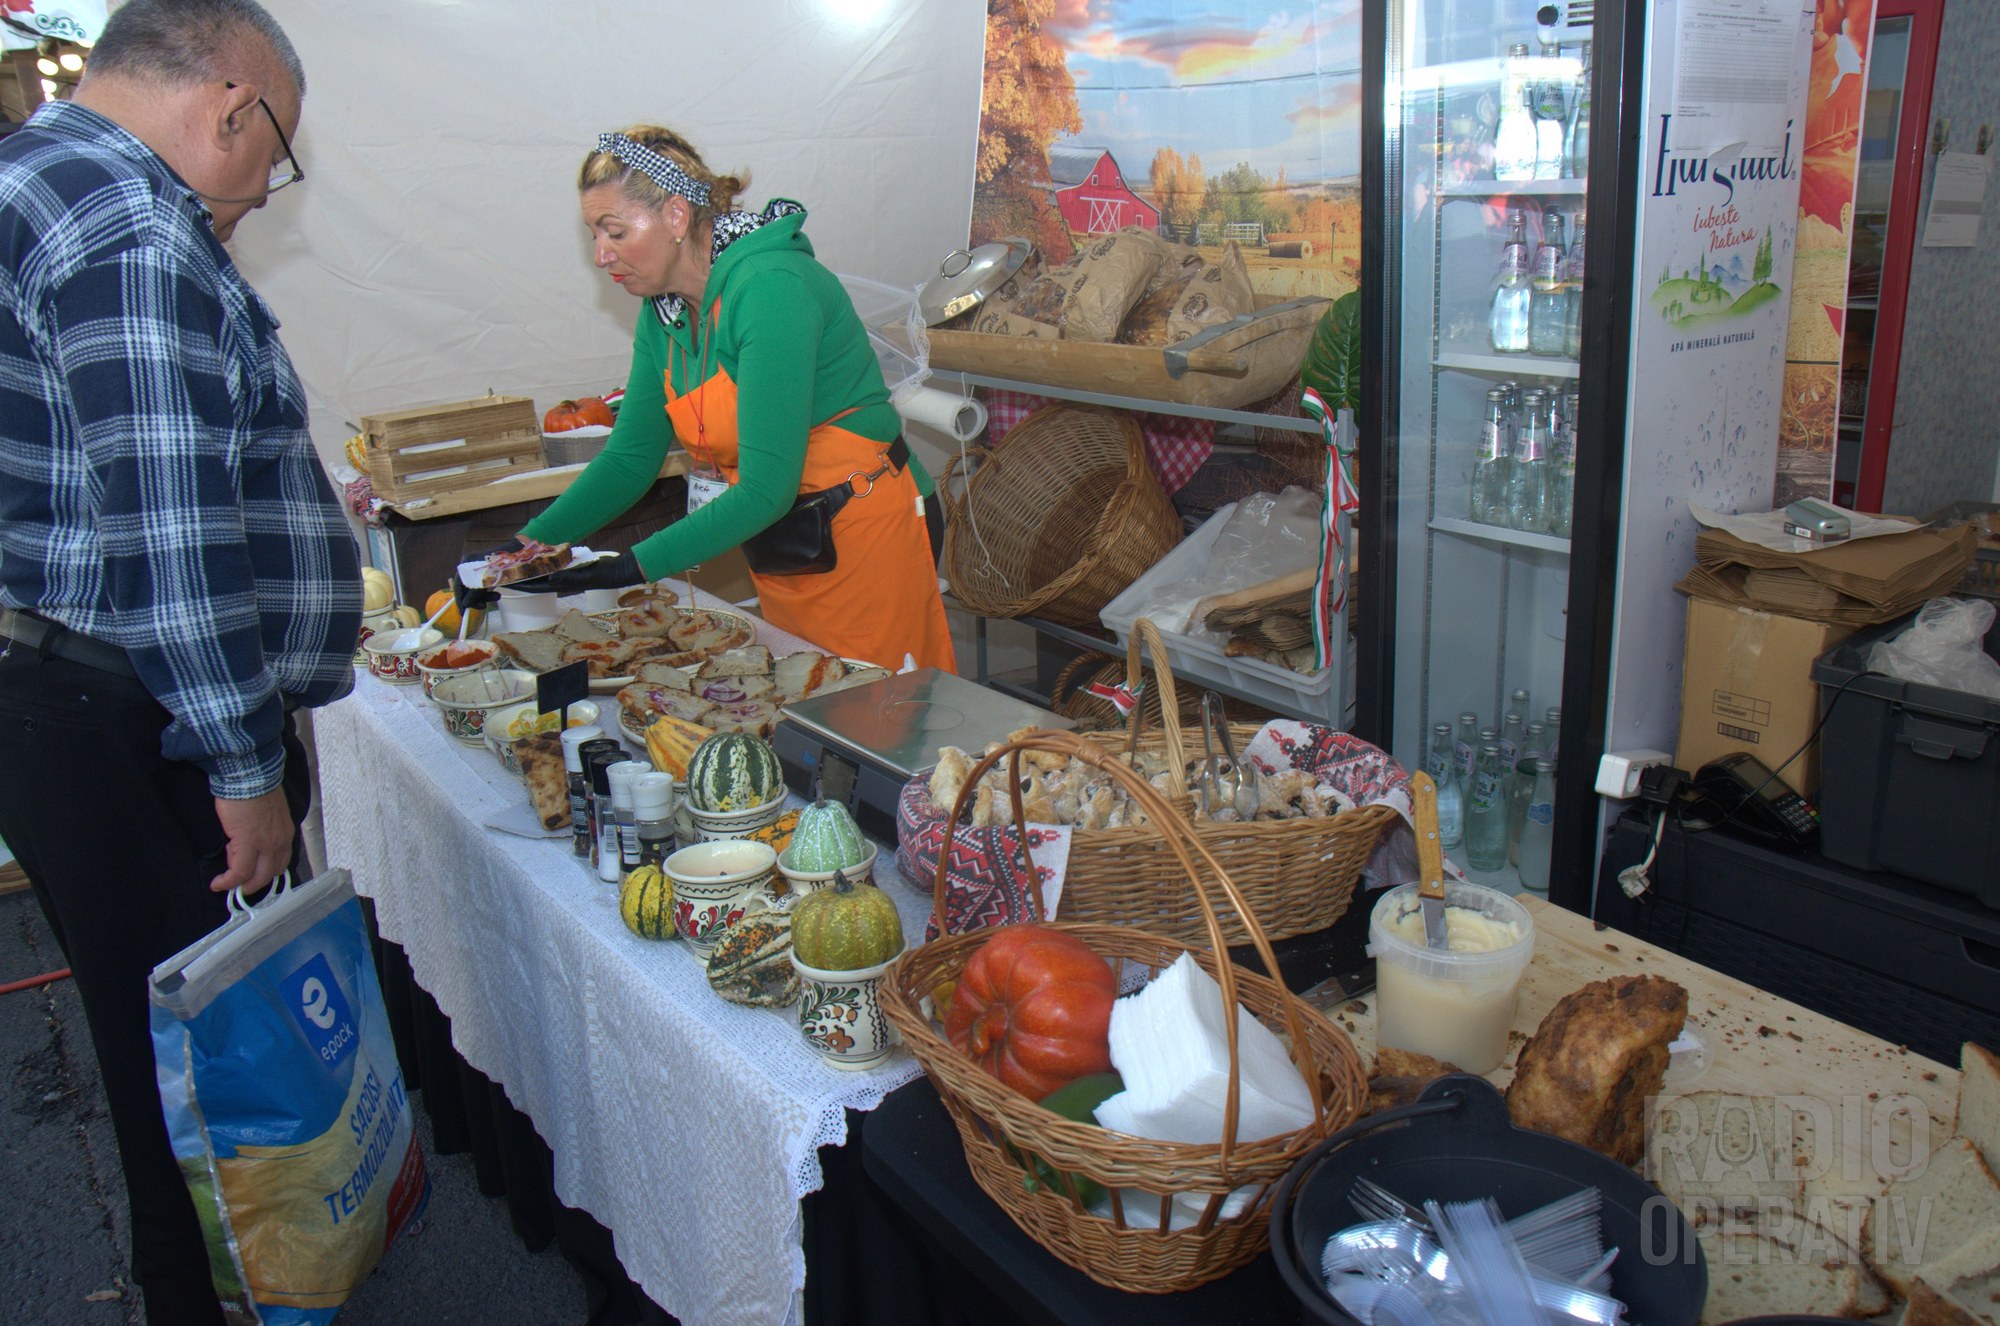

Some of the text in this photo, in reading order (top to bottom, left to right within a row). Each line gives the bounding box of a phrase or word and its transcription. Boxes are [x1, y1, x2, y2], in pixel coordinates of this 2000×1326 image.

[1670, 329, 1755, 353] APĂ MINERALĂ NATURALĂ
